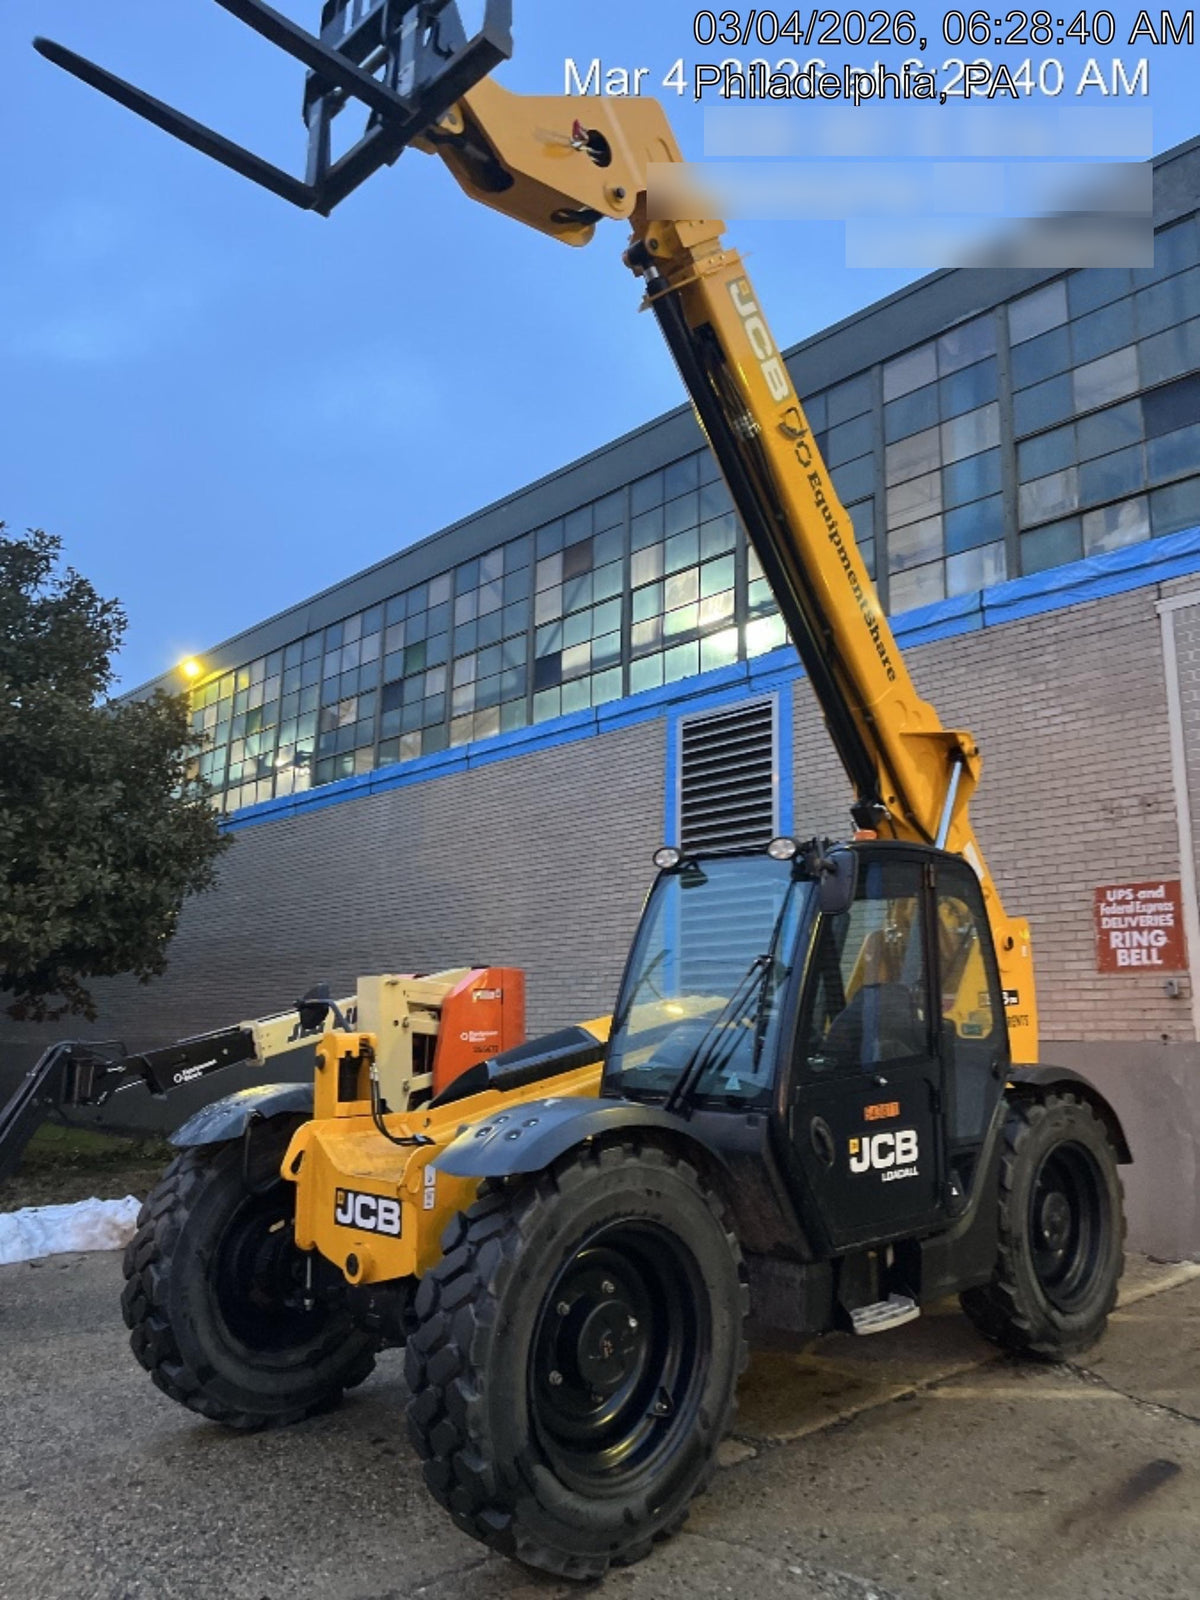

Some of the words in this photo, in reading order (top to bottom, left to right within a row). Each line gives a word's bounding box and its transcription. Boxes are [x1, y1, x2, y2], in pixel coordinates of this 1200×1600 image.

[728, 280, 790, 402] JCB
[807, 470, 896, 682] EquipmentShare
[1106, 888, 1134, 901] UPS
[1137, 885, 1166, 898] and
[1101, 914, 1175, 928] DELIVERIES
[1110, 930, 1168, 949] RING
[1116, 947, 1164, 967] BELL
[849, 1129, 919, 1173] JCB
[336, 1190, 401, 1235] JCB
